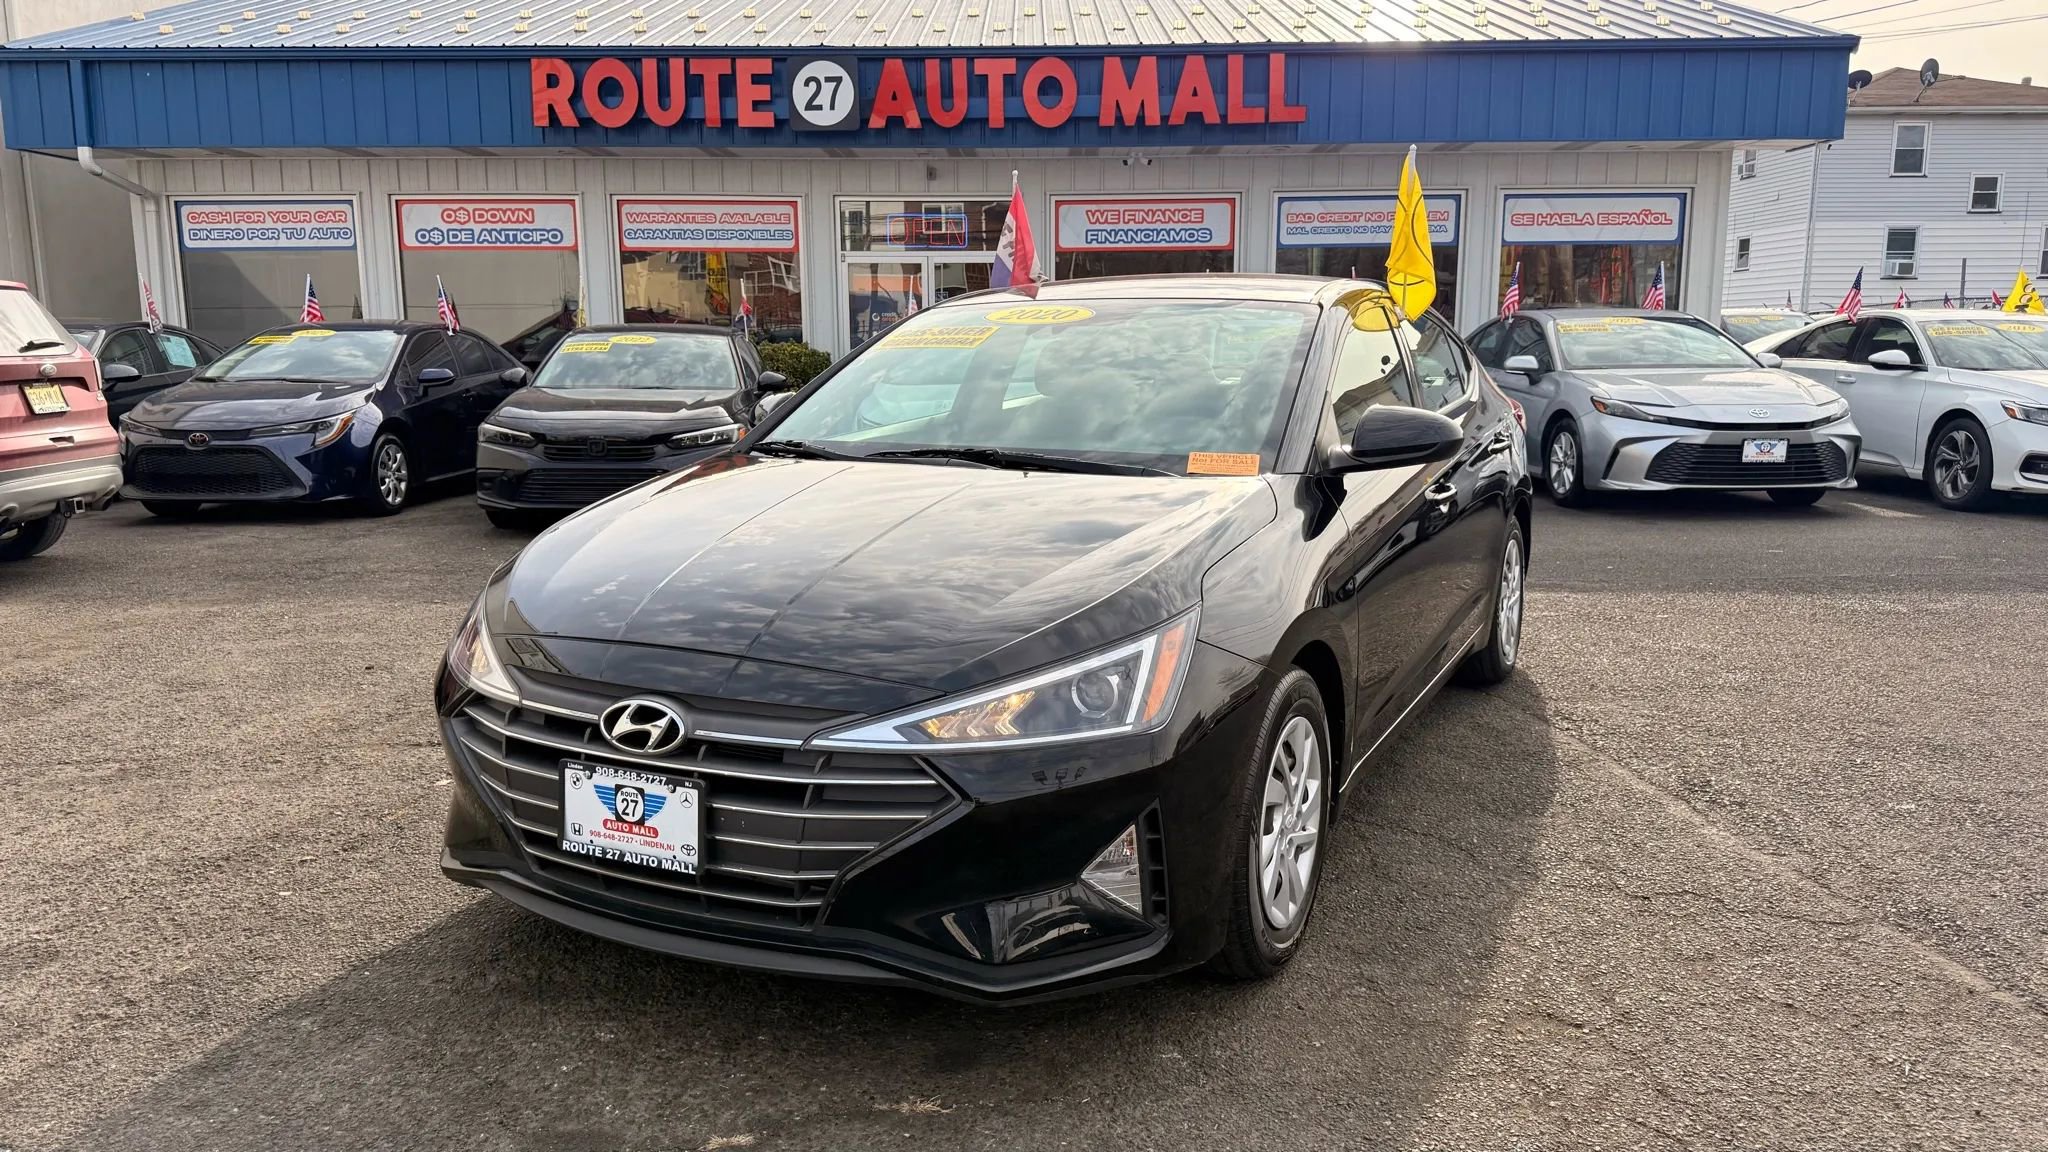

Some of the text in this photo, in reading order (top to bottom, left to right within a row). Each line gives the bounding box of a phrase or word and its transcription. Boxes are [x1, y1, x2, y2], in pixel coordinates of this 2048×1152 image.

[530, 53, 1307, 129] ROUTE 27 AUTO MALL
[187, 210, 347, 224] CASH FOR YOUR CAR
[473, 208, 535, 224] DOWN
[625, 212, 790, 224] WARRANTIES AVAILABLE
[1086, 208, 1204, 224] WE FINANCE
[1287, 211, 1449, 223] BAD CREDIT NO PLEM
[1511, 209, 1673, 226] SE HABLA ESPAÑOL
[189, 228, 352, 241] DINERO POR TU AUTO
[447, 228, 475, 244] DE
[477, 228, 563, 245] ANTICIPO
[624, 229, 793, 241] GARANTIAS DISPONIBLES
[890, 218, 965, 246] OPEN
[1085, 228, 1212, 244] FINANCIAMOS
[1286, 227, 1309, 235] MAL
[1311, 226, 1351, 234] CREDITO
[1353, 226, 1369, 234] NO
[1370, 226, 1392, 234] HAY
[999, 309, 1078, 321] 2020
[595, 766, 667, 784] 908-648-2727
[620, 790, 639, 799] ROUTE
[621, 797, 639, 818] 27
[589, 830, 634, 844] 908-648-2727
[606, 820, 656, 838] AUTO MALL
[562, 840, 697, 876] ROUTE 27 AUTO MALL
